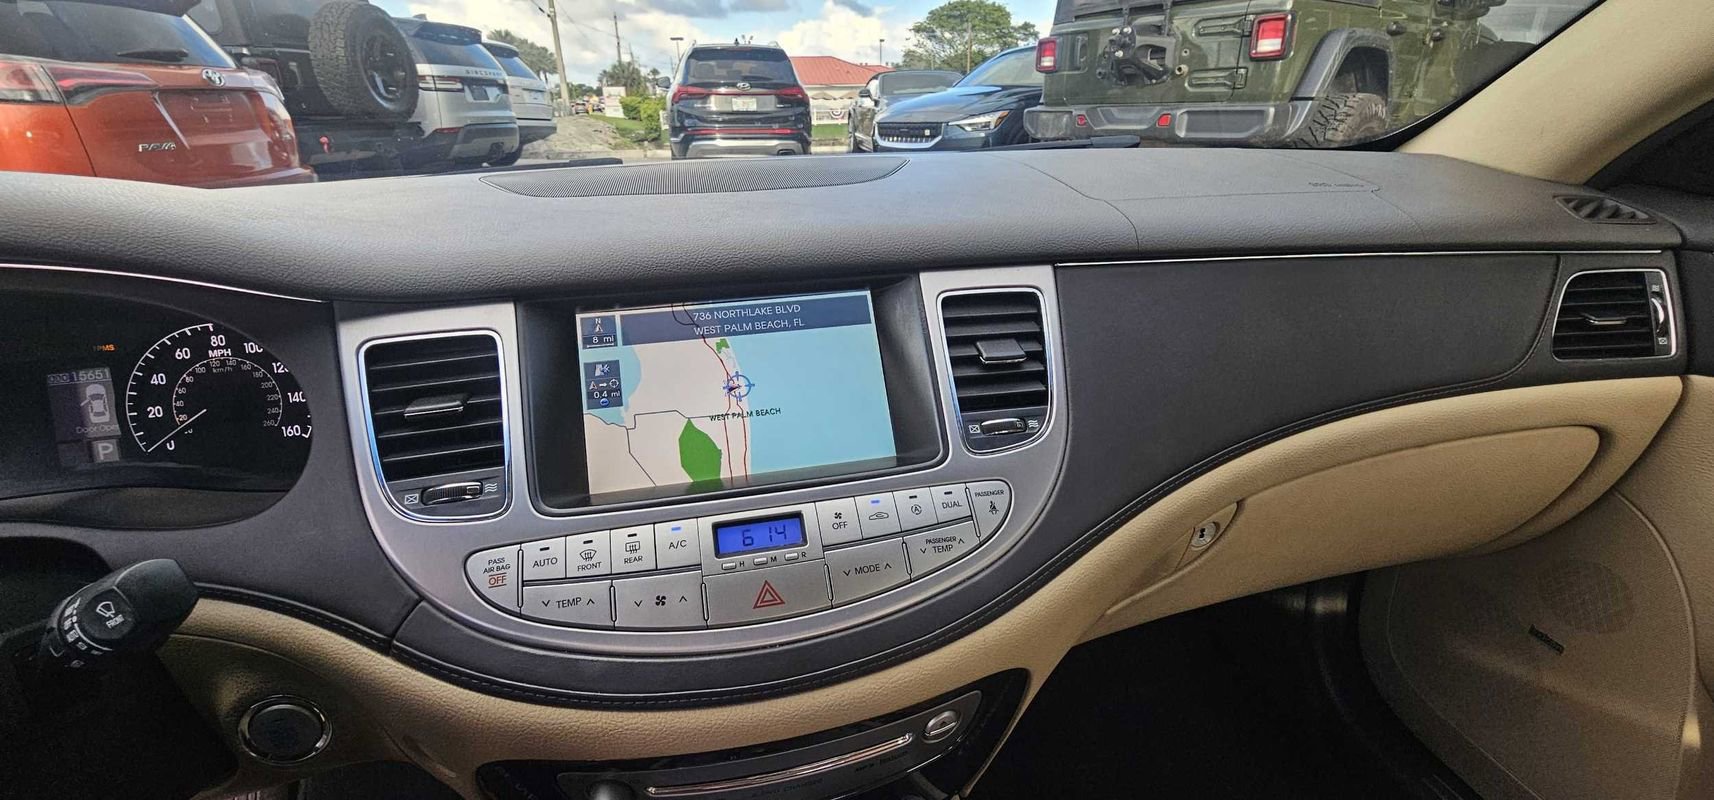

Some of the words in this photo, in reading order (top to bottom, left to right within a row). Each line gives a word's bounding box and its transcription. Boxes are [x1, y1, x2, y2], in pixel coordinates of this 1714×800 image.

[693, 312, 712, 322] 736
[714, 306, 773, 320] NORTHLAKE
[776, 304, 800, 316] BLVD
[694, 325, 722, 336] WEST
[724, 322, 752, 333] PALM
[754, 319, 790, 330] BEACH,
[793, 318, 805, 328] FL
[210, 334, 226, 346] 80
[592, 336, 599, 344] 8
[175, 347, 190, 360] 60
[208, 348, 232, 358] MPH
[72, 368, 110, 381] 15651
[195, 366, 206, 374] 100
[212, 366, 232, 374] km/h
[150, 373, 166, 386] 40
[147, 406, 162, 418] 20
[709, 413, 730, 422] WEST
[732, 410, 754, 420] PALM
[756, 408, 782, 417] BEACH
[281, 425, 301, 437] 160
[97, 443, 113, 460] P
[974, 490, 1004, 498] PASSENGER
[942, 500, 962, 509] DUAL
[832, 521, 848, 530] OFF
[742, 529, 754, 546] 6
[768, 524, 787, 542] 14
[926, 536, 956, 544] PASSENGER
[668, 539, 687, 550] A/C
[932, 544, 954, 554] TEMP
[488, 557, 506, 566] PASS
[532, 557, 558, 568] AUTO
[624, 555, 643, 564] REAR
[739, 560, 745, 568] H
[482, 566, 495, 574] AIR
[496, 564, 511, 572] BAG
[576, 562, 602, 572] FRONT
[855, 564, 880, 576] MODE
[488, 575, 508, 586] OFF
[556, 598, 582, 609] TEMP
[106, 614, 125, 629] FRONT
